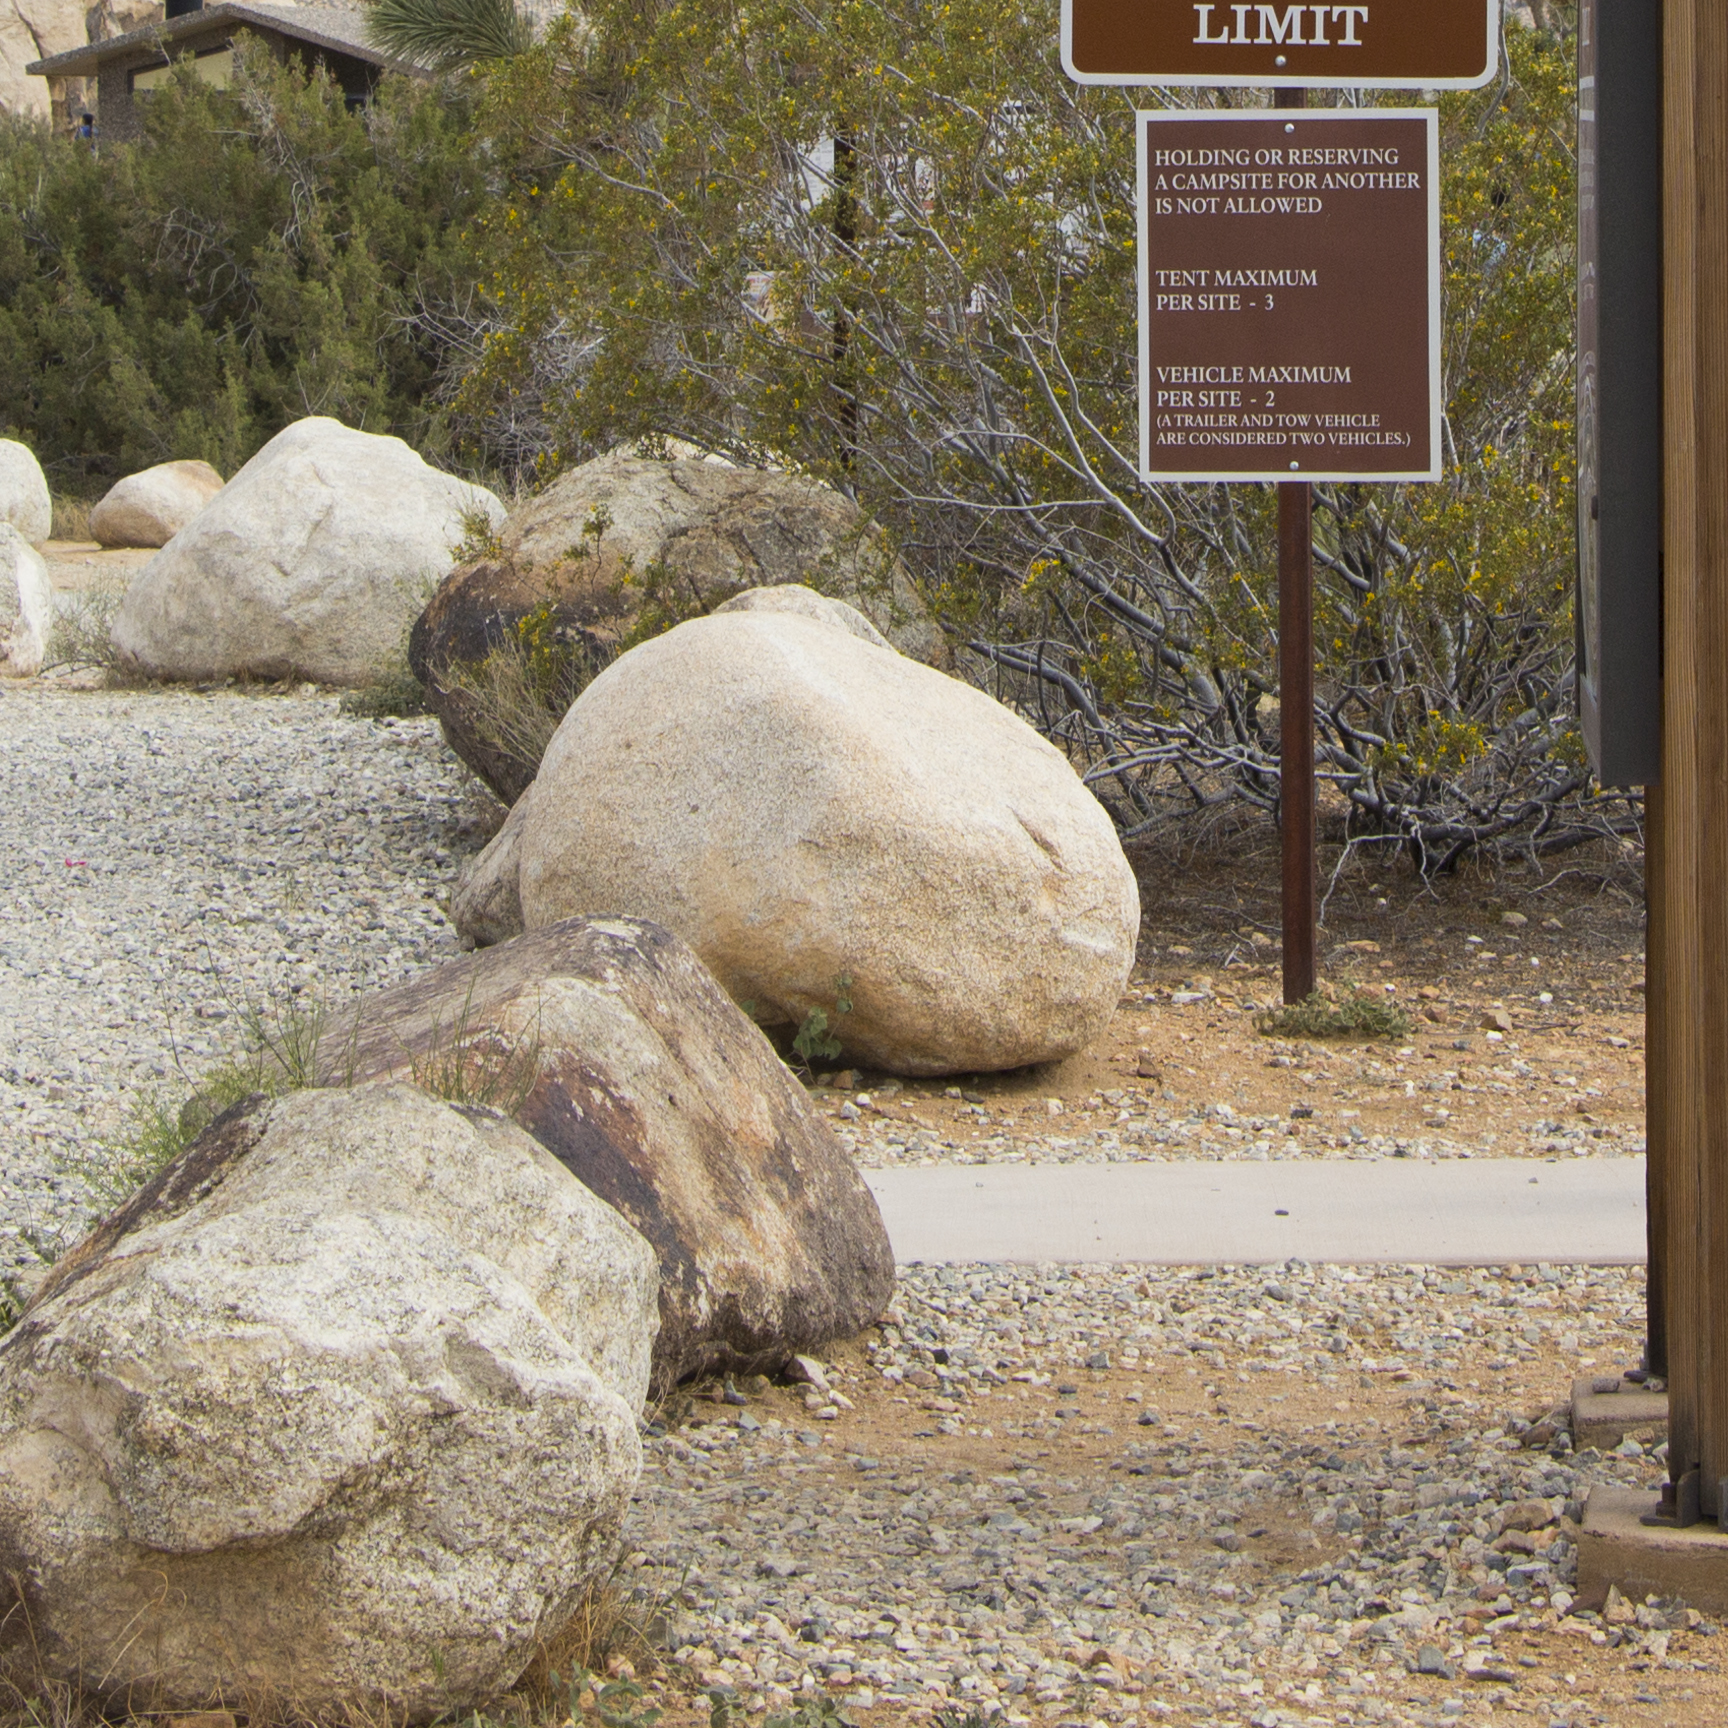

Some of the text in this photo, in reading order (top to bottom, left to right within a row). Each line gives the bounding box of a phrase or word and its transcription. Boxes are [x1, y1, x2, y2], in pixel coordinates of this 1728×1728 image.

[1192, 4, 1368, 45] LIMIT
[1155, 148, 1398, 165] HOLDING OR RESERVING
[1155, 172, 1420, 190] A CAMPSITE FOR ANOTHER
[1155, 197, 1322, 214] IS NOT ALLOWED
[1155, 269, 1317, 286] TENT MAXIMUM
[1156, 294, 1193, 310] PER
[1197, 294, 1241, 310] SITE
[1264, 293, 1274, 310] 3
[1156, 366, 1350, 382] VEHICLE MAXIMUM
[1157, 390, 1194, 407] PER
[1198, 390, 1241, 407] SITE
[1265, 390, 1274, 406] 2
[1156, 413, 1380, 428] (A TRAILER AND TOW VEHICLE
[1156, 431, 1410, 446] ARE CONSIDERED TWO VEHICLES.)
